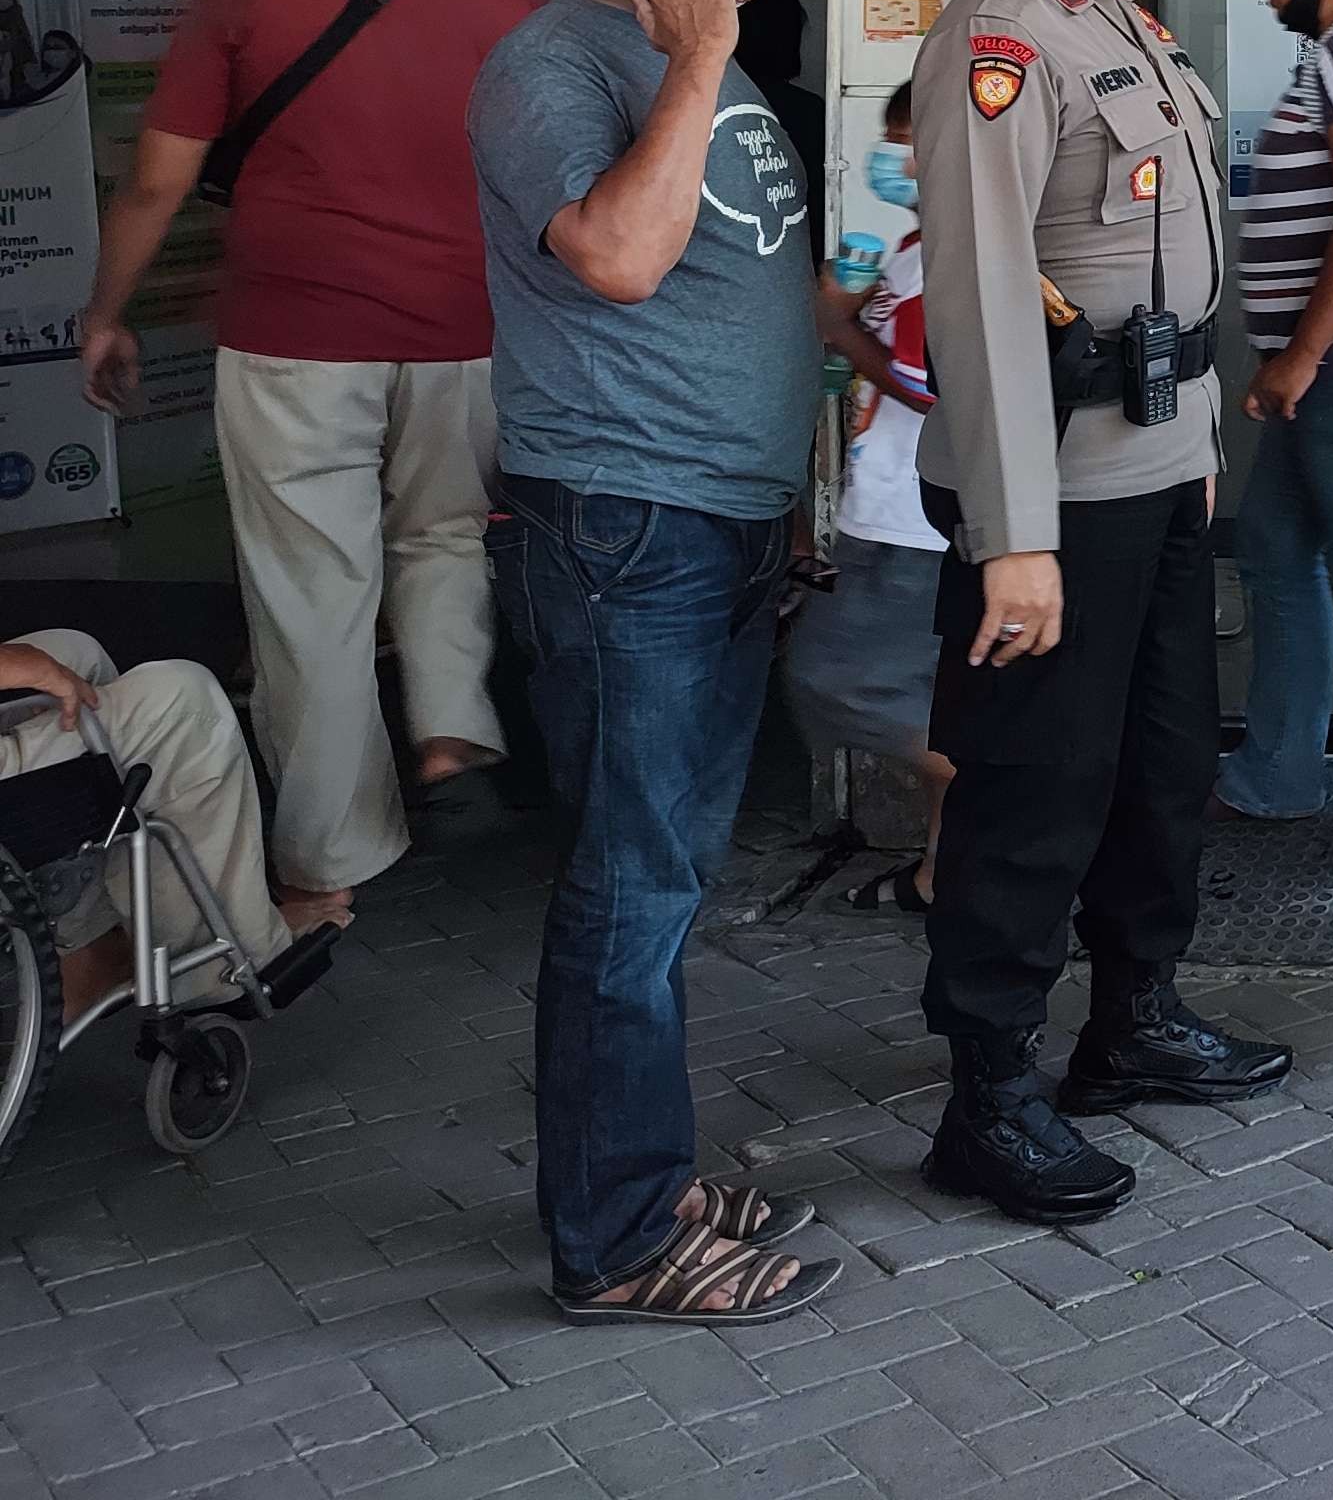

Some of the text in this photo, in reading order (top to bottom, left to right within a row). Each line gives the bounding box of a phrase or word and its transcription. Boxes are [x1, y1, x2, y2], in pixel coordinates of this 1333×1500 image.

[976, 39, 1032, 61] PELOPOR
[733, 117, 777, 157] nggak
[752, 144, 789, 185] pakai
[765, 178, 797, 213] opini
[0, 246, 74, 262] Pelayanan
[54, 463, 92, 484] 165
